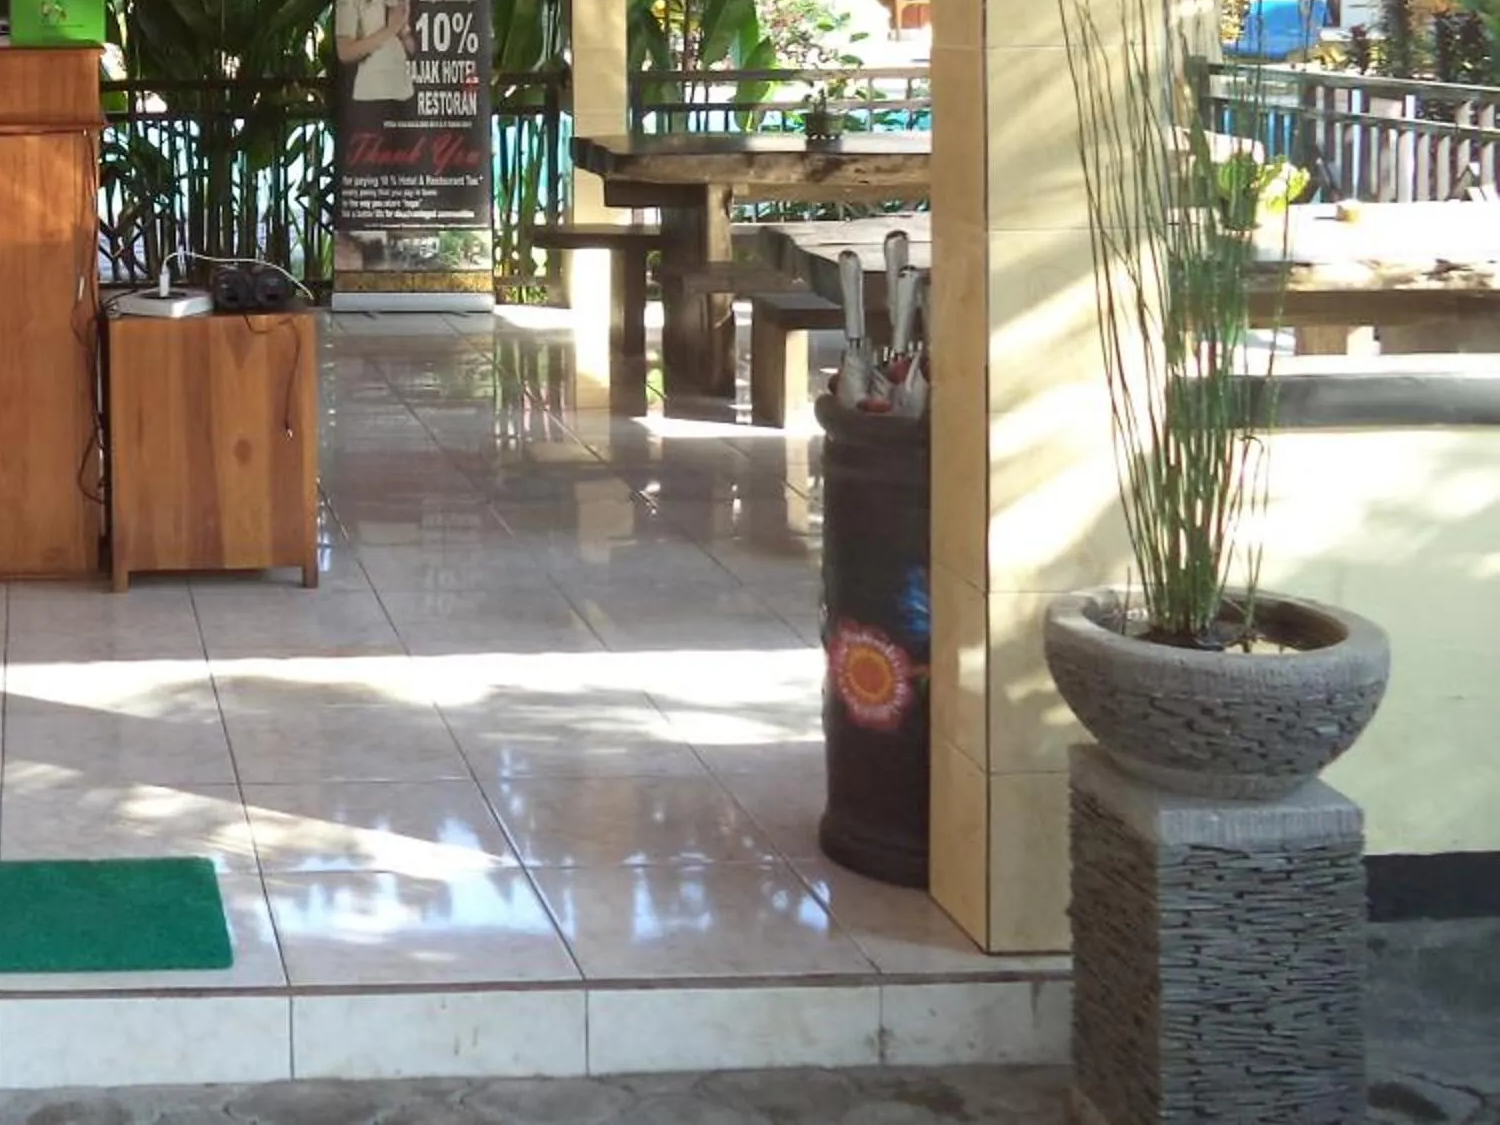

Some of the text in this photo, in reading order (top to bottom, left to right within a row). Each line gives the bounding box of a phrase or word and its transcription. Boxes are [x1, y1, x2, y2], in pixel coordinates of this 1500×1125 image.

[415, 11, 479, 54] 10%
[417, 90, 477, 116] RESTORAN
[346, 133, 427, 166] Thank
